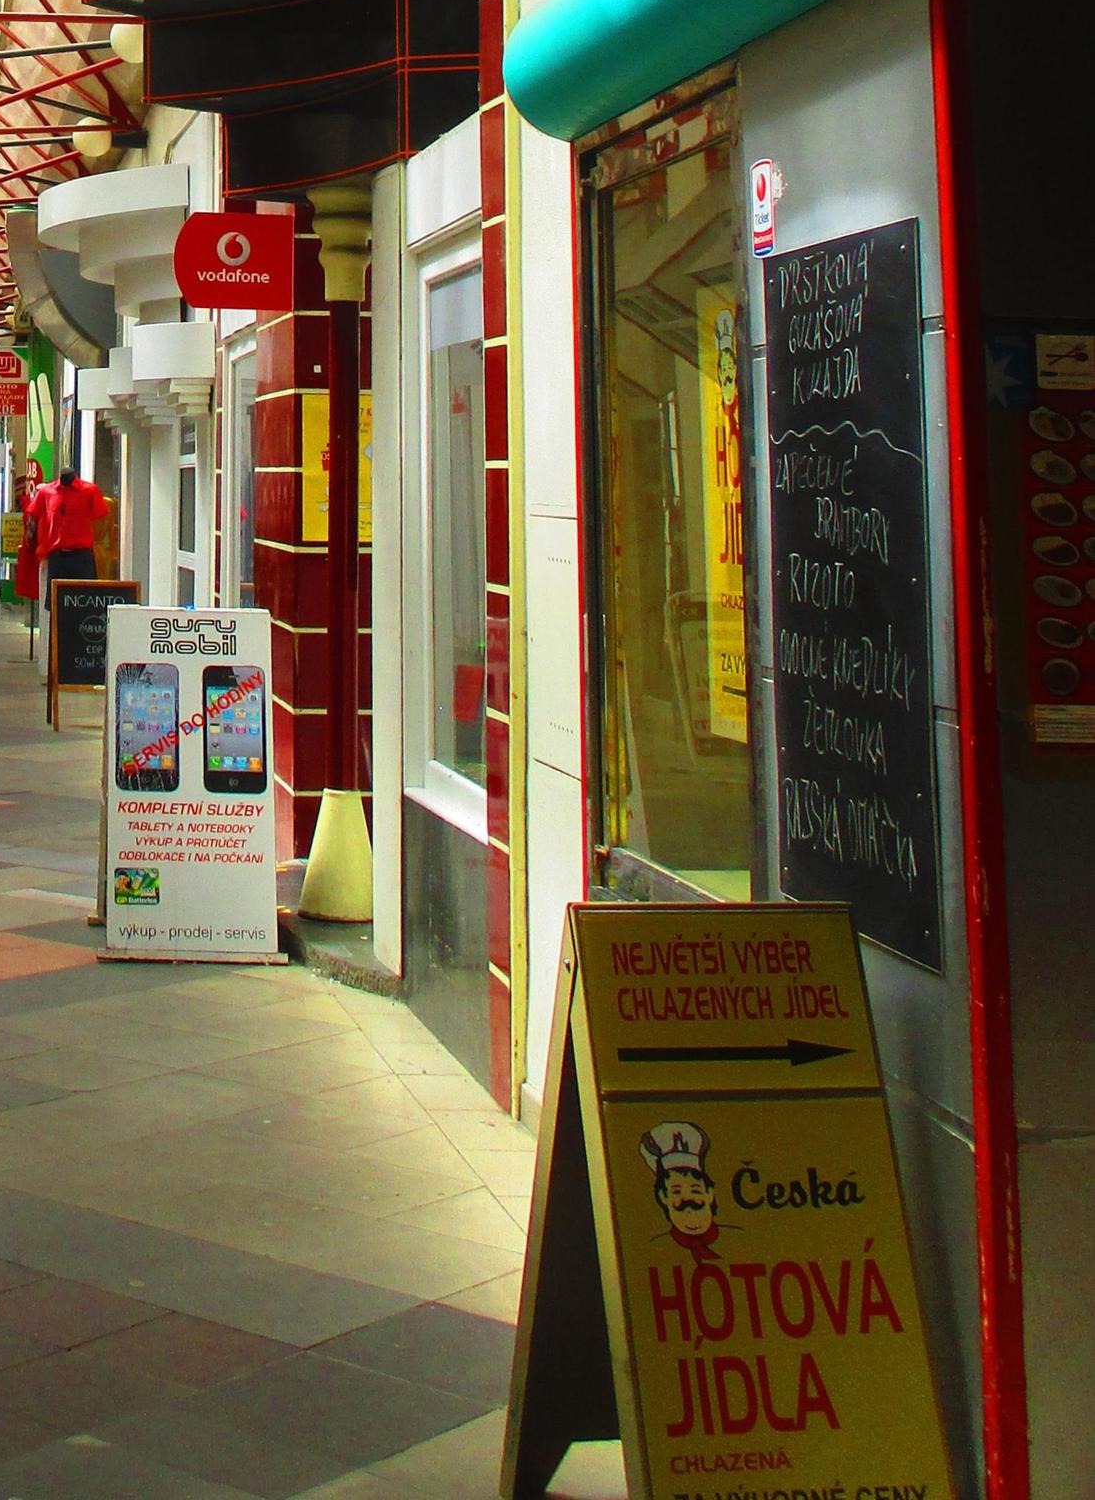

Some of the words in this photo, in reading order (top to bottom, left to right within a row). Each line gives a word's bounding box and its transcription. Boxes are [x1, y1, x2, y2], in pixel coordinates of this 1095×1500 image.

[197, 268, 270, 284] vodafone
[788, 553, 855, 610] RIZOTO
[150, 618, 236, 639] guru
[150, 634, 237, 655] mobil
[122, 730, 179, 776] SERVIS
[179, 713, 206, 735] DO
[206, 671, 264, 718] HODINY
[117, 800, 203, 816] KOMPLETNÍ
[206, 802, 264, 817] SLUŽBY
[128, 821, 173, 831] TABLETY
[177, 823, 184, 832] A
[187, 823, 254, 834] NOTEBOOKY
[135, 836, 173, 846] VÝKUP
[175, 838, 183, 847] A
[118, 851, 184, 862] ODBLOKACE
[194, 853, 210, 862] NA
[214, 852, 264, 864] POČKÁNÍ
[118, 923, 157, 940] výkup
[168, 925, 213, 941] prodej
[224, 926, 266, 940] servis
[611, 934, 726, 977] NEJVĚTŠÍ
[736, 931, 815, 975] VÝBĚR
[617, 976, 774, 1022] CHLAZENÝCH
[784, 977, 850, 1020] JÍDEL
[731, 1161, 866, 1211] Česká
[648, 1238, 904, 1344] HOTOVÁ
[667, 1337, 842, 1439] JÍDLA
[670, 1446, 793, 1477] CHLAZENÁ
